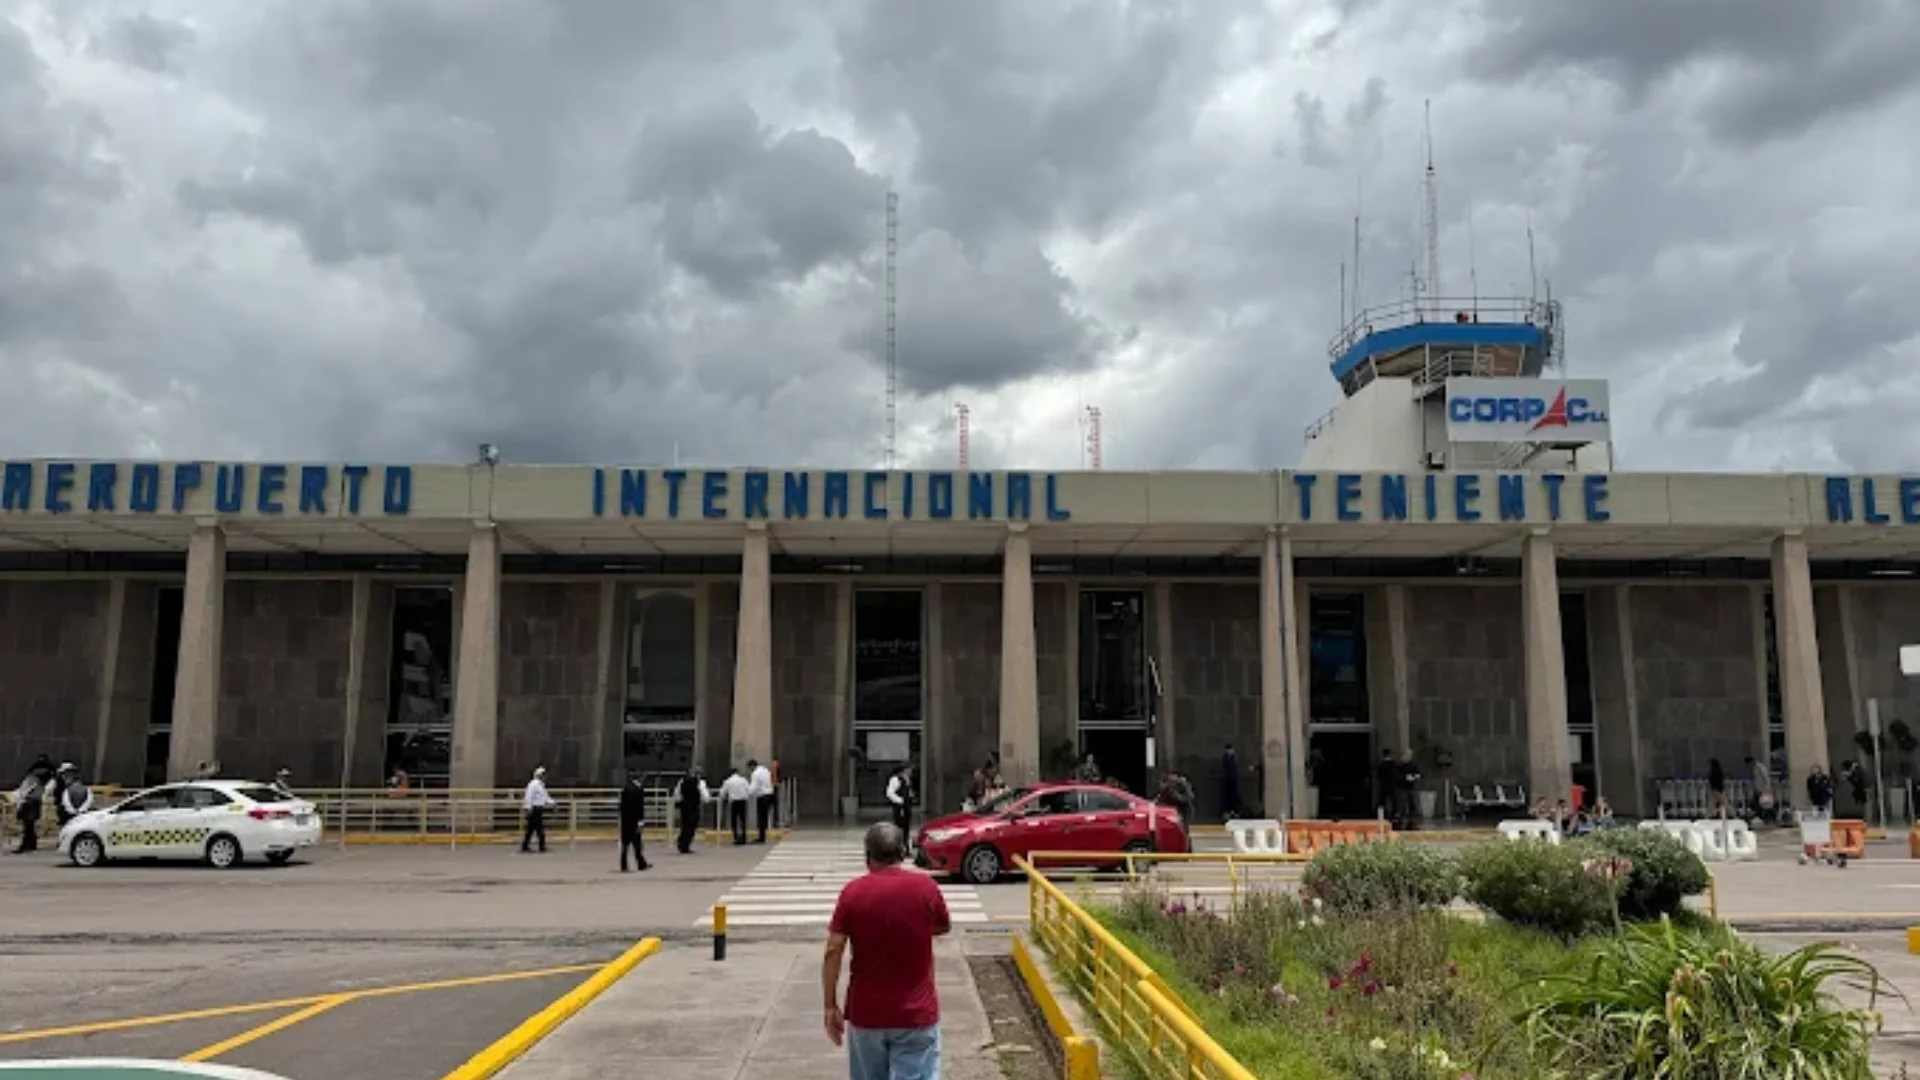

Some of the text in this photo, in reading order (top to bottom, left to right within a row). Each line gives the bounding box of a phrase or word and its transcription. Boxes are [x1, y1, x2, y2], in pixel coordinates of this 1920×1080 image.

[1449, 386, 1588, 430] CORPAC
[2, 462, 412, 515] AEROPUERTO
[592, 468, 1072, 520] INTERNACIONAL
[1294, 474, 1612, 521] TENIENTE
